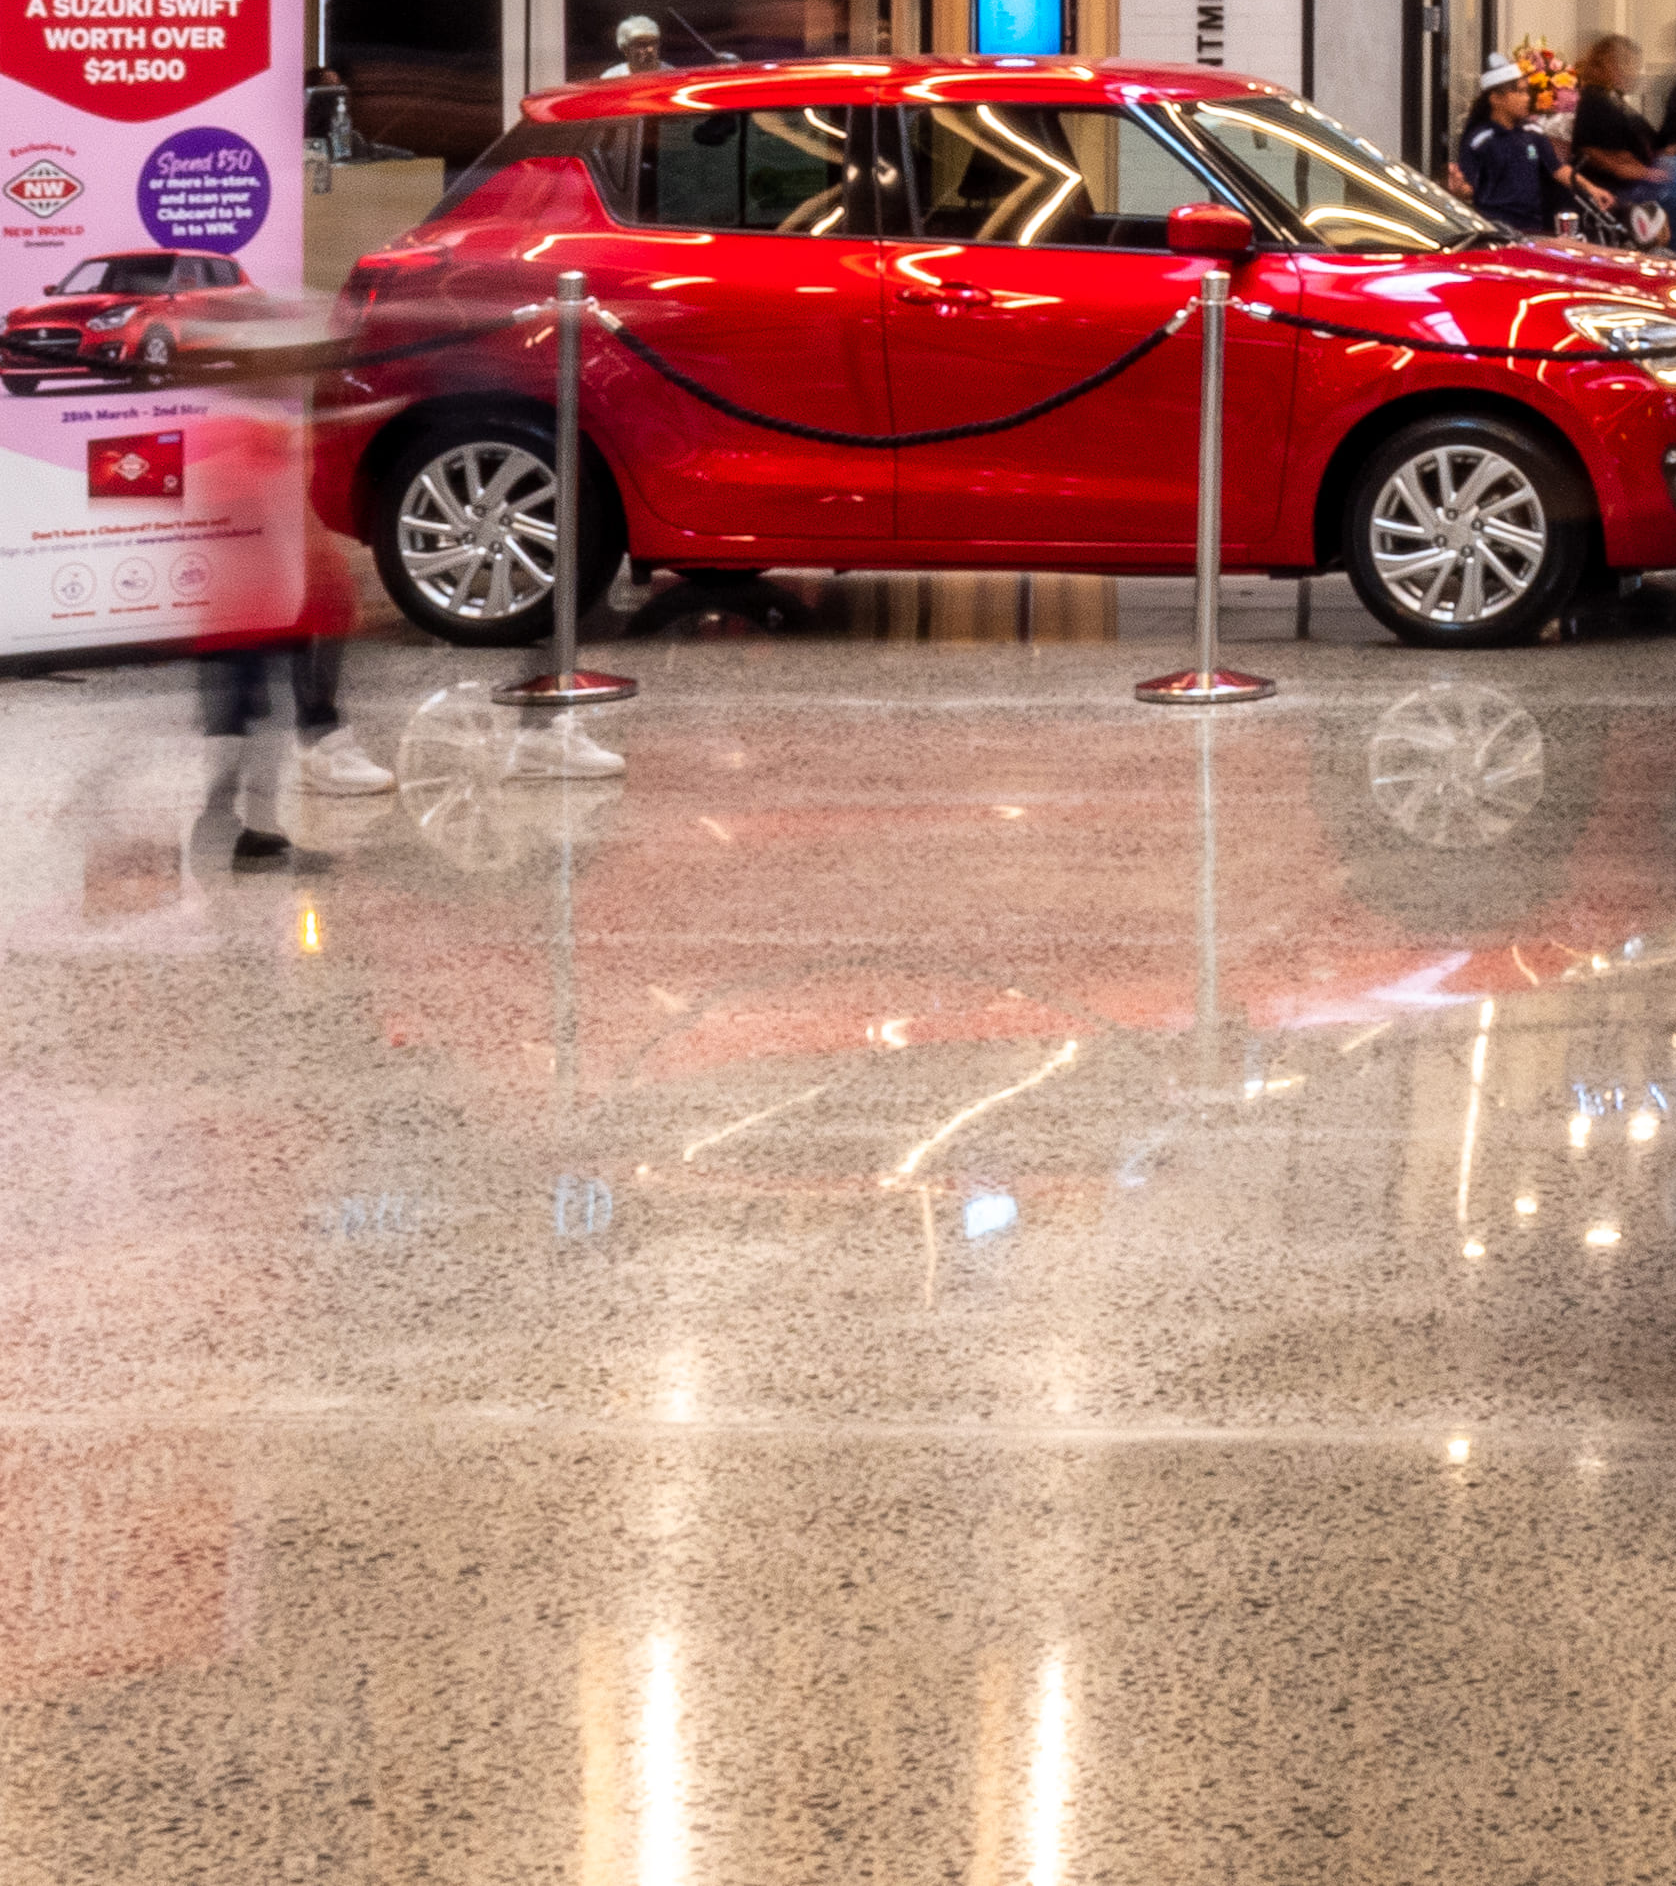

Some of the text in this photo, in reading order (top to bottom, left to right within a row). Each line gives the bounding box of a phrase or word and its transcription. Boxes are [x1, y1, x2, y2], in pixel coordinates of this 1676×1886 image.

[44, 26, 226, 50] WORTH OVER
[84, 57, 186, 85] $21,500
[24, 182, 65, 198] NW
